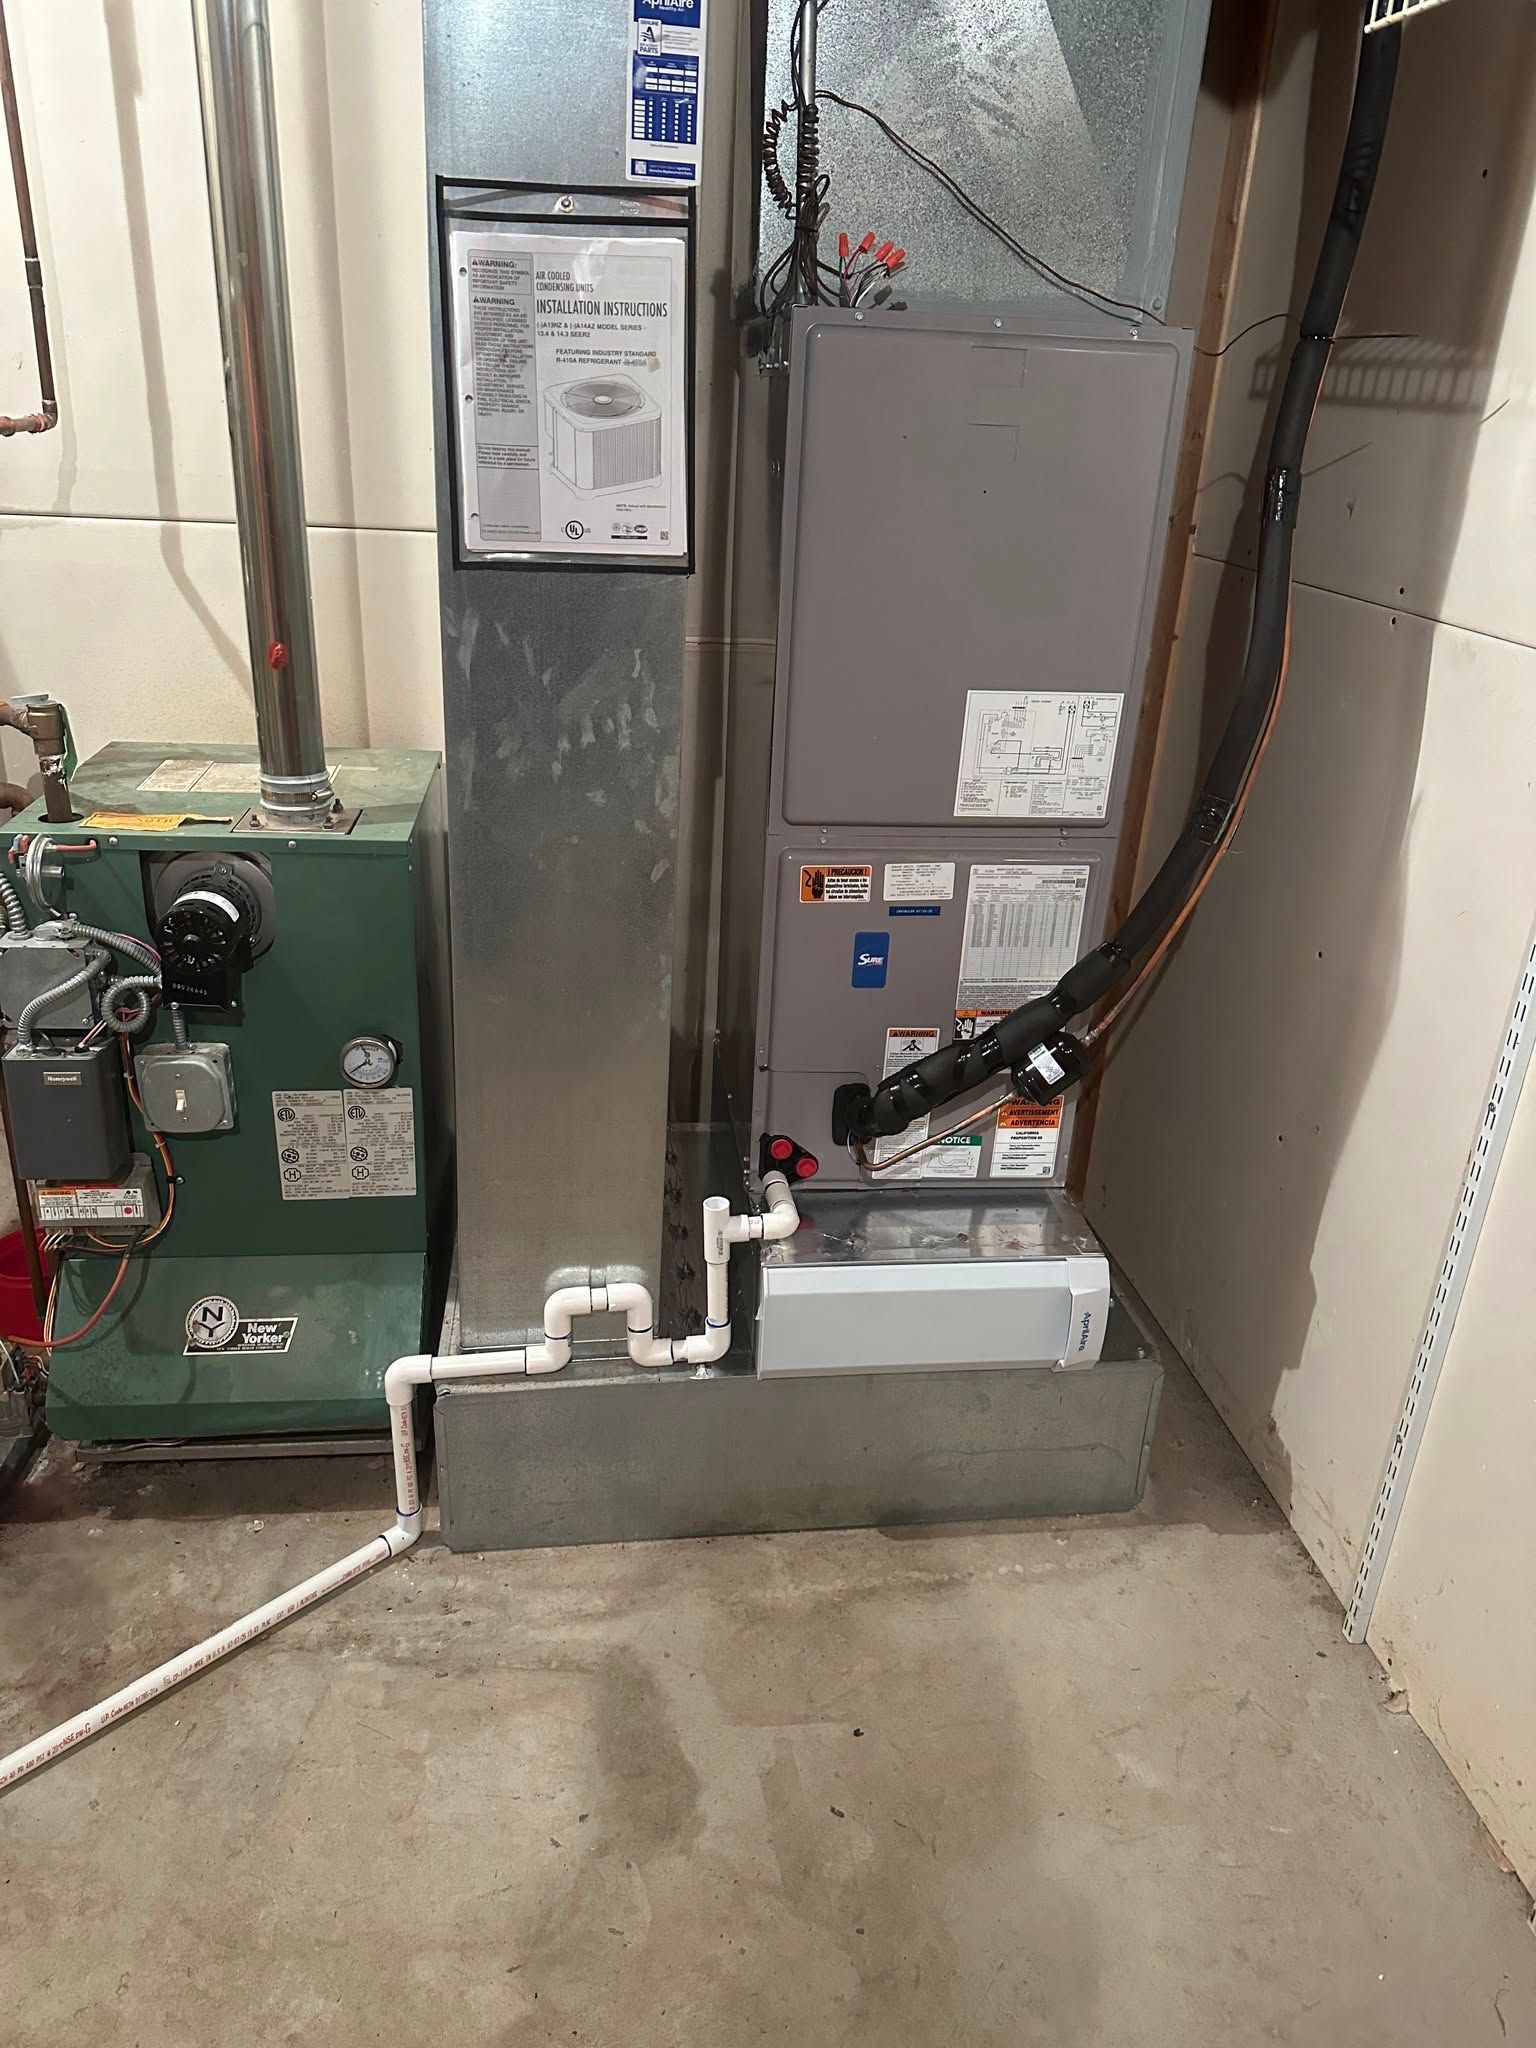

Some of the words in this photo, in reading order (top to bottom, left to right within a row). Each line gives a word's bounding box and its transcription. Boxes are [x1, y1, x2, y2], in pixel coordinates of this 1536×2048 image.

[640, 46, 659, 54] PARTS
[536, 271, 546, 281] AIR
[547, 271, 571, 281] COOLED
[536, 282, 575, 292] CONDENSING
[575, 283, 594, 293] UNITS
[480, 297, 515, 306] WARNING
[536, 299, 601, 316] INSTALLATION
[603, 301, 668, 318] INSTRUCTIONS
[596, 323, 619, 331] MODEL
[555, 348, 591, 356] FEATURING
[578, 358, 622, 366] REFRIGERANT
[899, 1030, 935, 1038] WARNING
[202, 1306, 224, 1322] N
[197, 1320, 226, 1338] Y
[247, 1322, 277, 1333] New
[1078, 1311, 1092, 1352] AprilAire
[242, 1333, 284, 1344] Yorker
